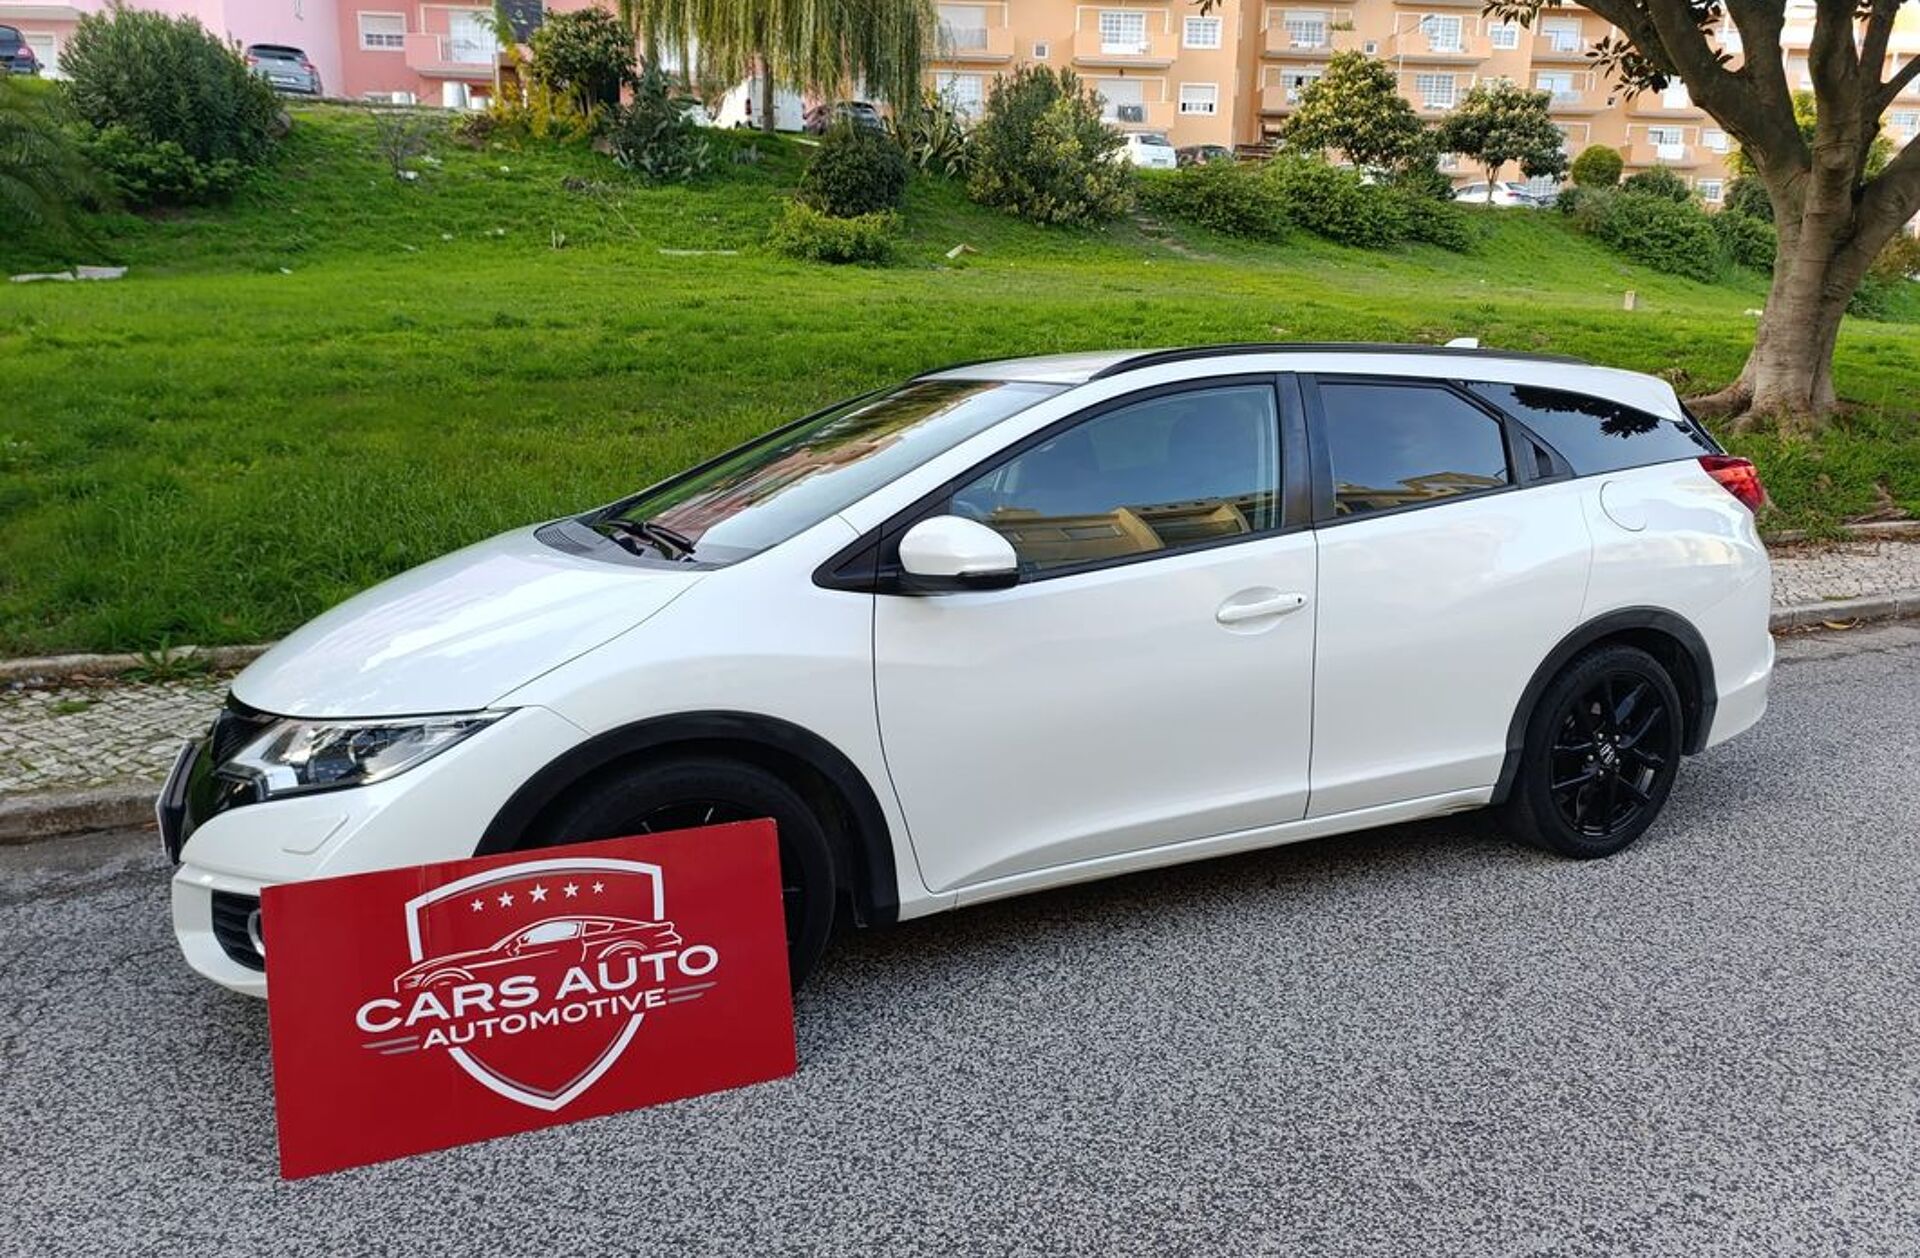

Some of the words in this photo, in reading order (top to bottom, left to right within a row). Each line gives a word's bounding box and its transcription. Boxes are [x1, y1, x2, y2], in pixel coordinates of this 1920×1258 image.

[356, 975, 538, 1033] CARS
[556, 945, 719, 1000] AUTO
[423, 989, 667, 1049] AUTOMOTIVE
